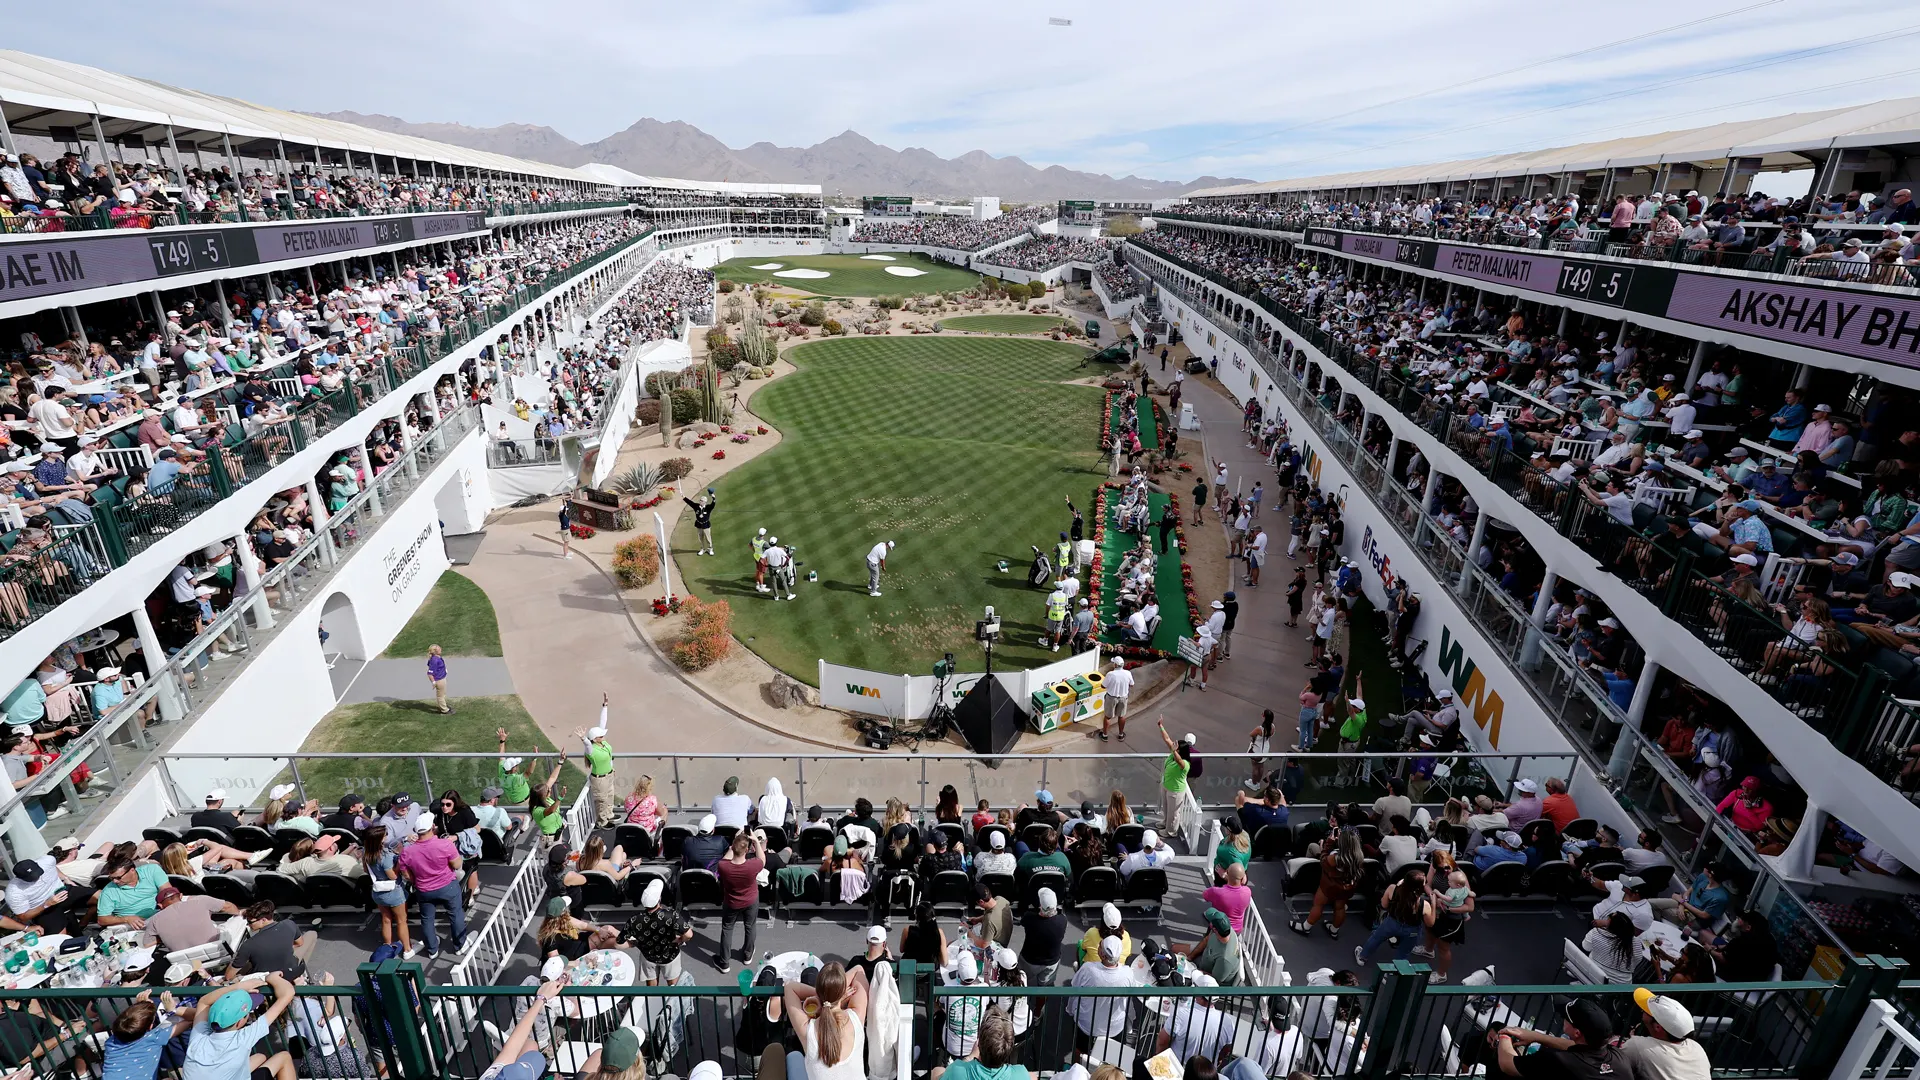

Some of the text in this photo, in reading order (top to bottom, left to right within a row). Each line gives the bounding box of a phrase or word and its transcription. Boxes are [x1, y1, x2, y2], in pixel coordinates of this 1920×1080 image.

[283, 227, 359, 253] PETER MALNATI
[374, 224, 388, 241] T49
[392, 228, 400, 238] -5
[152, 240, 191, 269] T49
[201, 238, 219, 263] -5
[1398, 244, 1409, 260] T49
[1412, 247, 1420, 262] -5
[47, 250, 84, 283] IM
[1452, 251, 1532, 282] PETER MALNATI
[1562, 266, 1591, 292] T49
[1601, 273, 1622, 298] -5
[1719, 288, 1862, 340] AKSHAY
[1301, 440, 1322, 488] WM
[383, 547, 397, 570] THE
[388, 522, 433, 586] GREENEST SHOW
[1368, 538, 1395, 590] FedEx
[392, 558, 421, 603] ON GRASS
[845, 683, 881, 699] WM
[952, 690, 970, 698] W
[1438, 624, 1504, 751] WM
